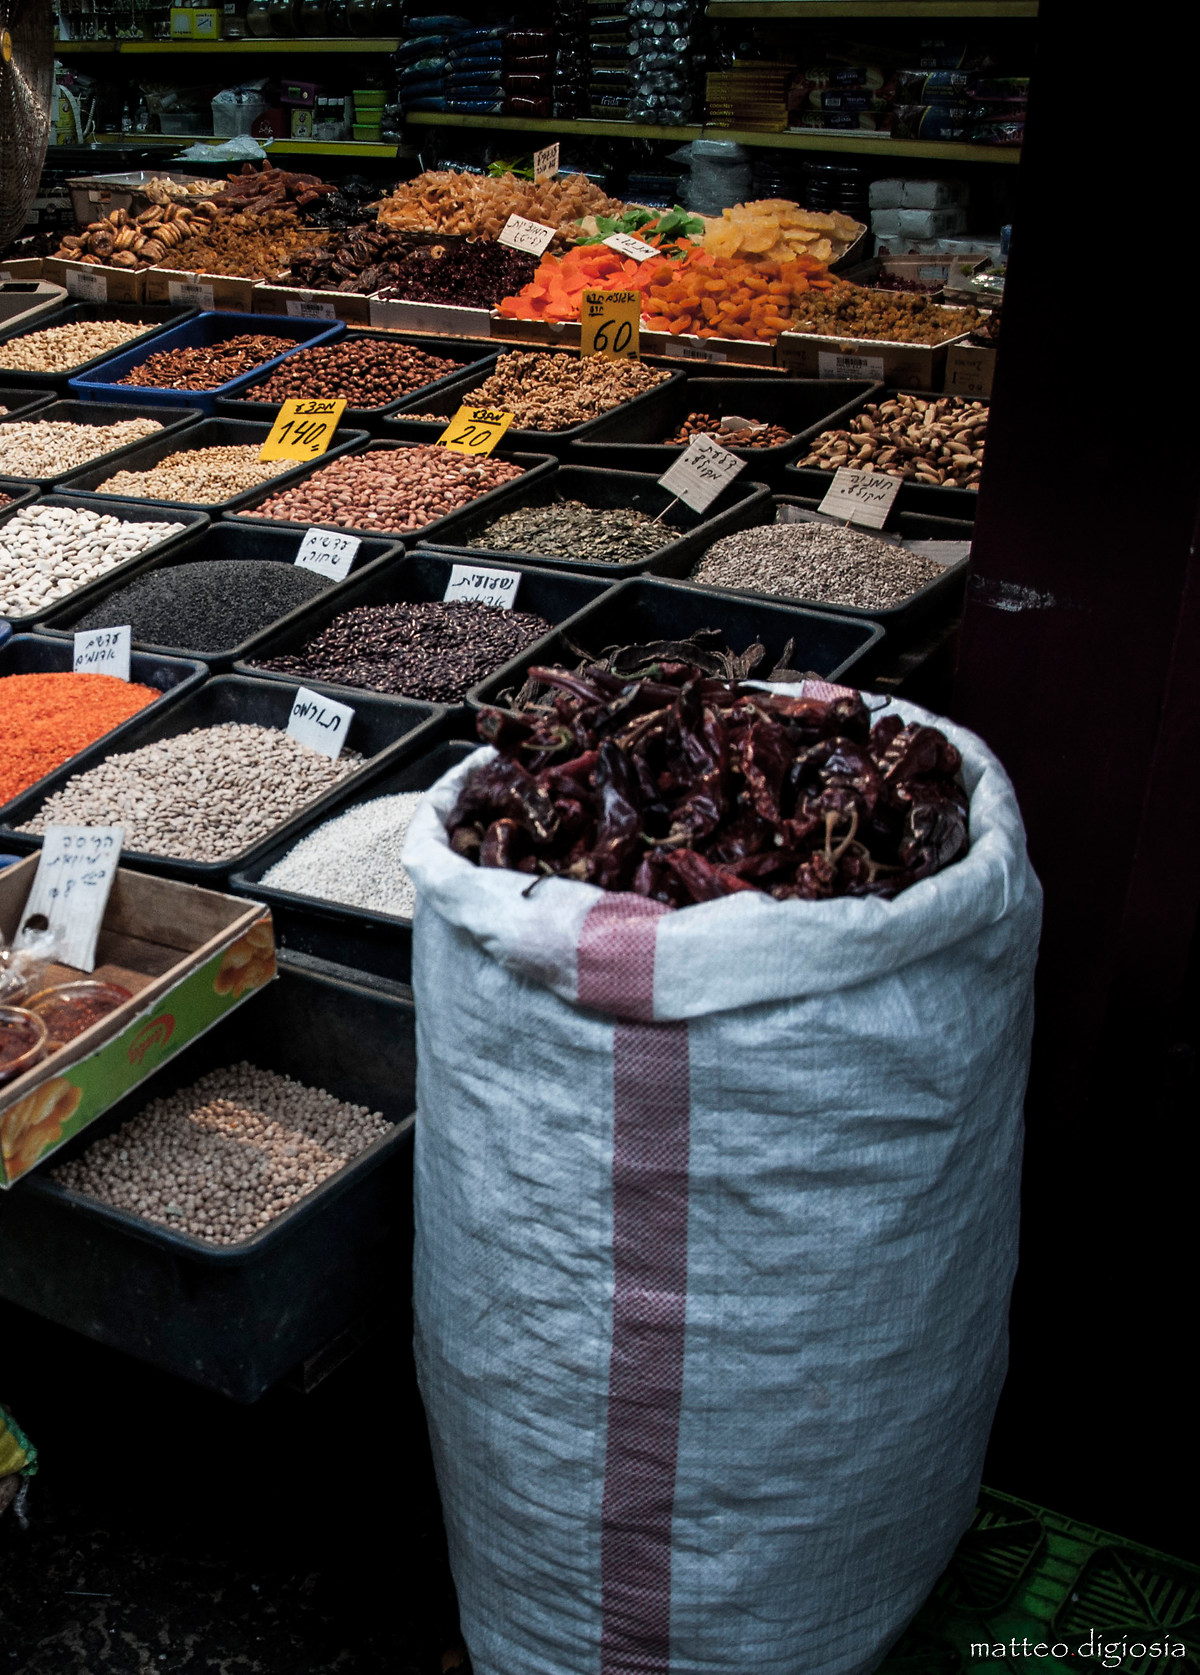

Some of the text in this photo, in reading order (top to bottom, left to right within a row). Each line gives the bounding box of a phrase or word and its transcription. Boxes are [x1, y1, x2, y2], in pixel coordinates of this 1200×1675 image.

[593, 319, 632, 352] 60
[294, 401, 336, 414] מבצע
[472, 409, 505, 422] מבצע
[278, 420, 327, 446] 140
[451, 425, 492, 447] 20
[698, 446, 737, 472] דלעת
[293, 702, 342, 732] תורמס
